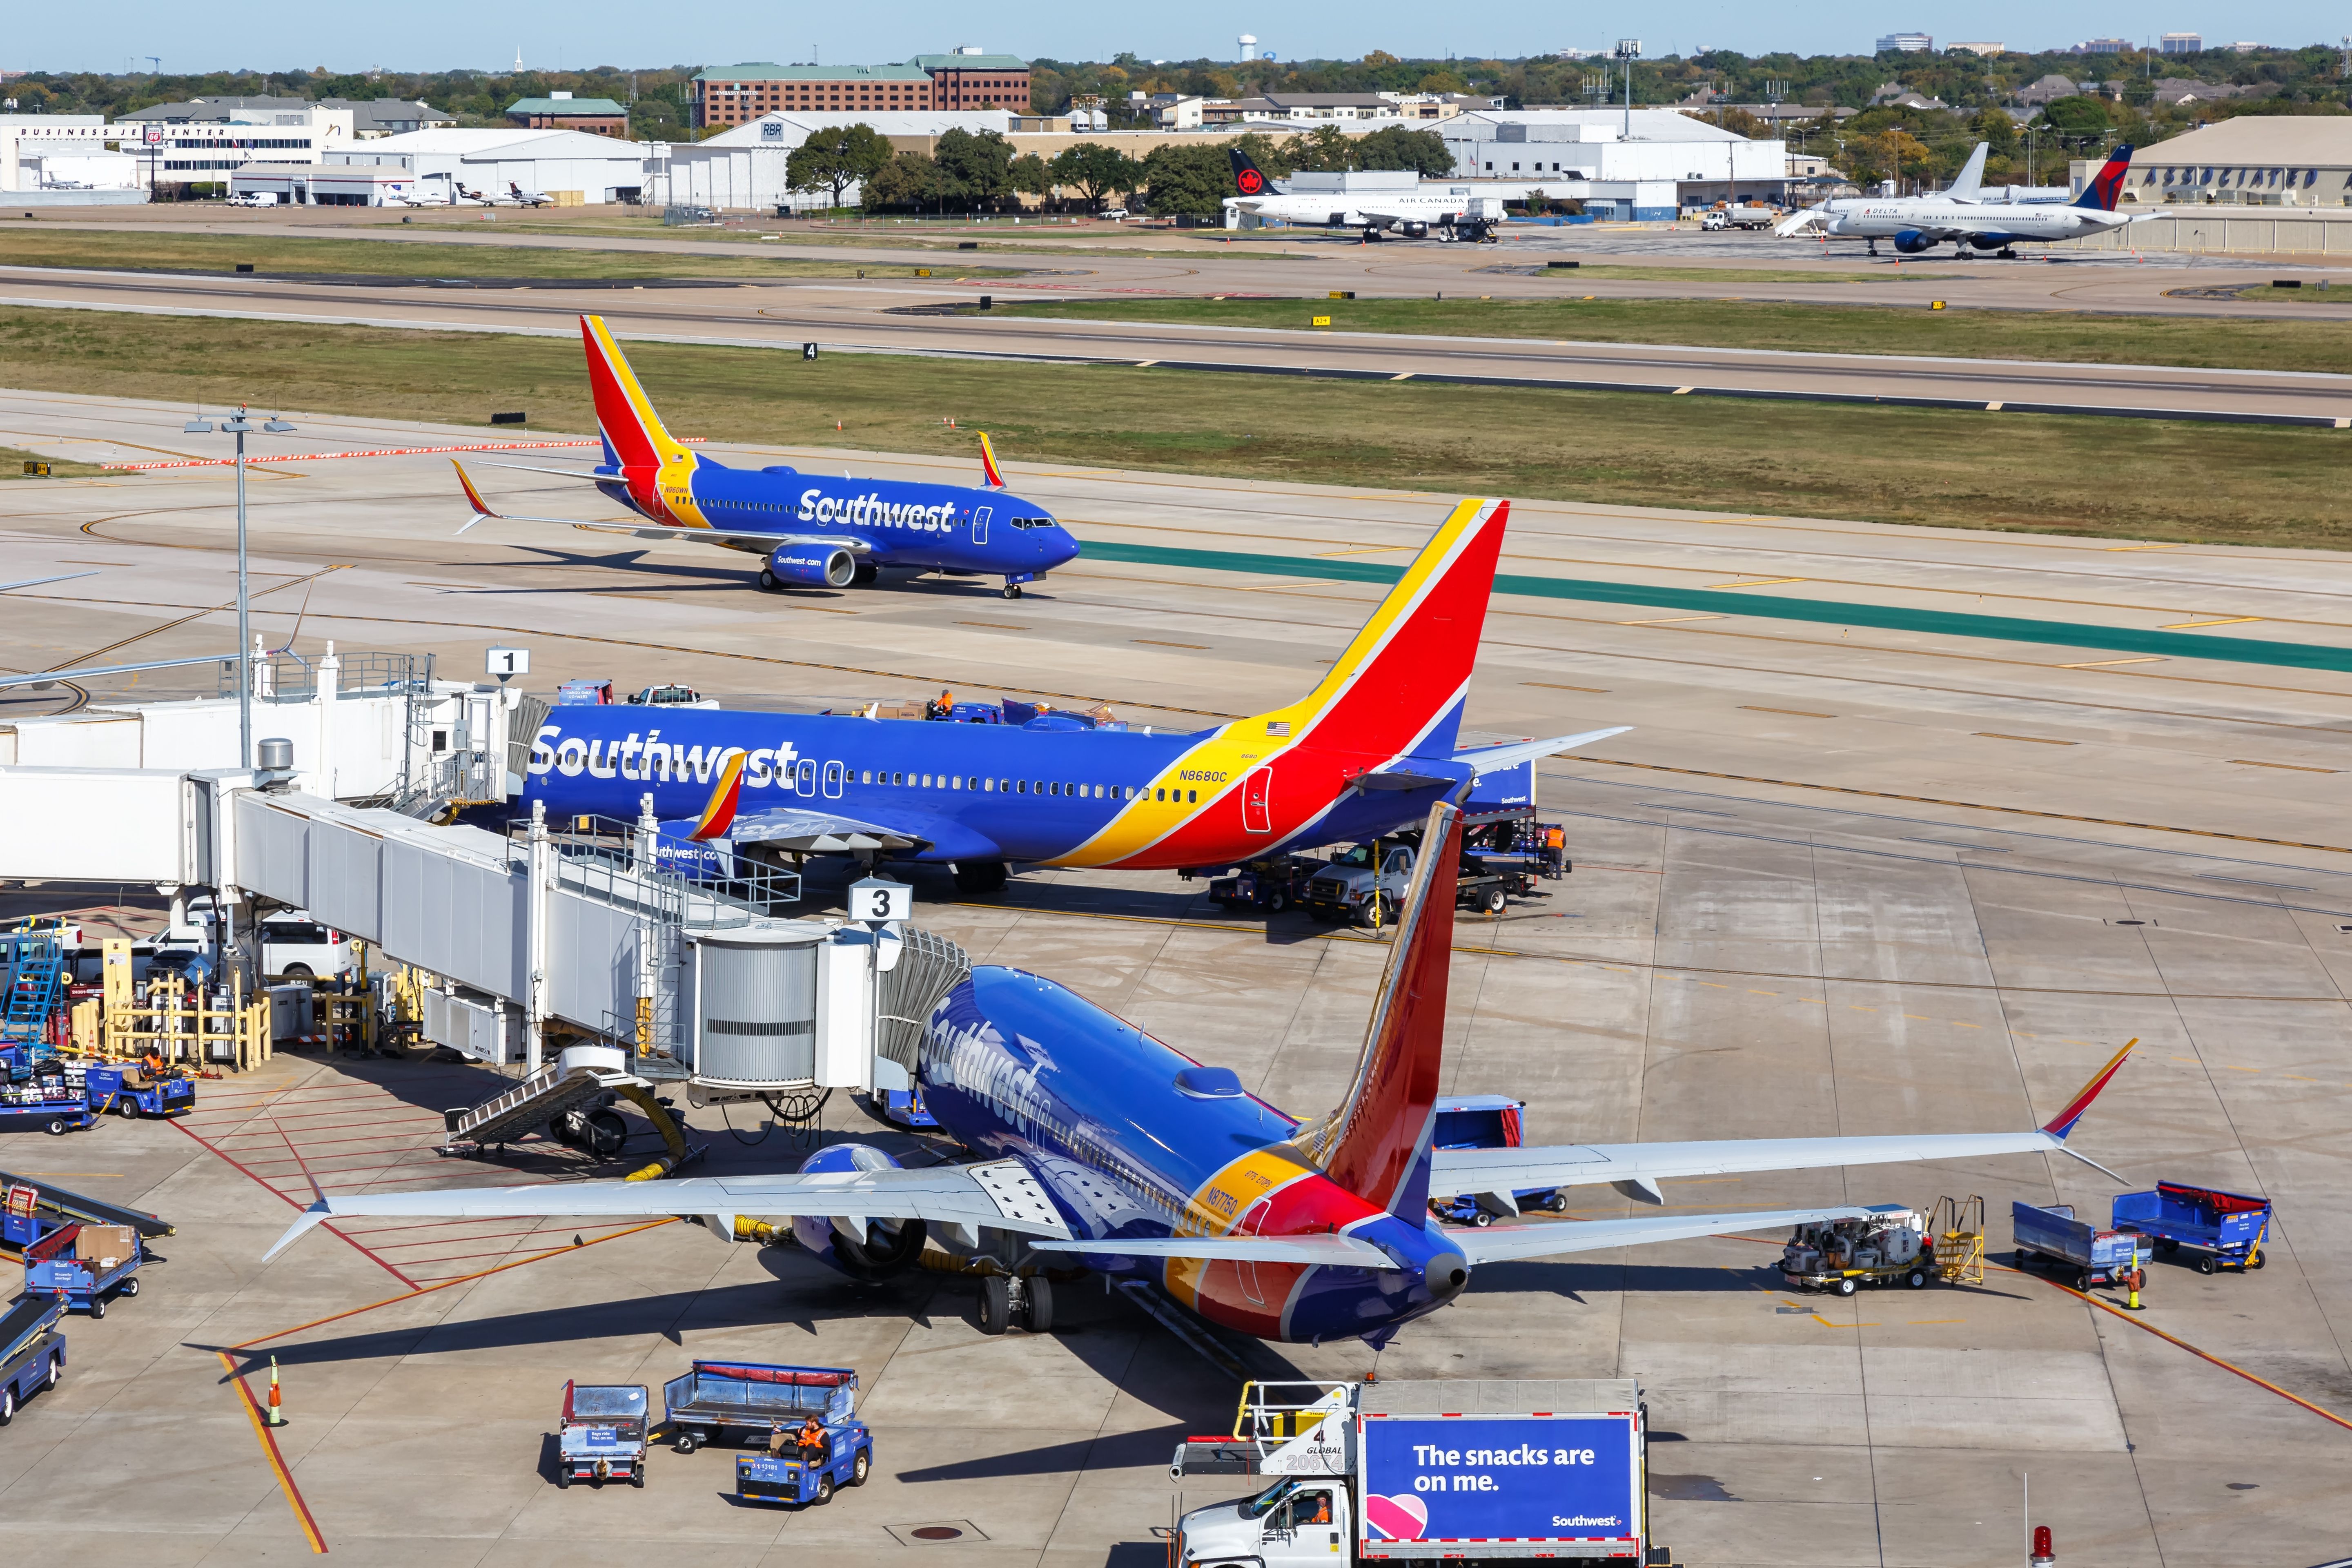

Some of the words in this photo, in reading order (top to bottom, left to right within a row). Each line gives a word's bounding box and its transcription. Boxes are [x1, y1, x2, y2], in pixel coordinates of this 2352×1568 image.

[763, 124, 782, 136] RBR
[2145, 166, 2318, 186] ASSOCIATED
[808, 344, 815, 358] 4
[797, 489, 956, 532] Southwest
[503, 653, 514, 671] 1
[527, 725, 799, 790] Southwest
[1179, 769, 1227, 782] N8680C
[1501, 796, 1526, 804] Southwest
[872, 889, 891, 918] 3
[1256, 1176, 1273, 1187] ETOPS
[1205, 1186, 1238, 1217] N8775Q
[1313, 1430, 1326, 1444] 4
[1286, 1454, 1344, 1470] 20674
[1413, 1444, 1460, 1466] The
[1466, 1443, 1549, 1466] snacks
[1554, 1448, 1595, 1466] are
[1414, 1475, 1446, 1492] on
[1453, 1475, 1499, 1492] me.
[1552, 1514, 1617, 1527] Southwest
